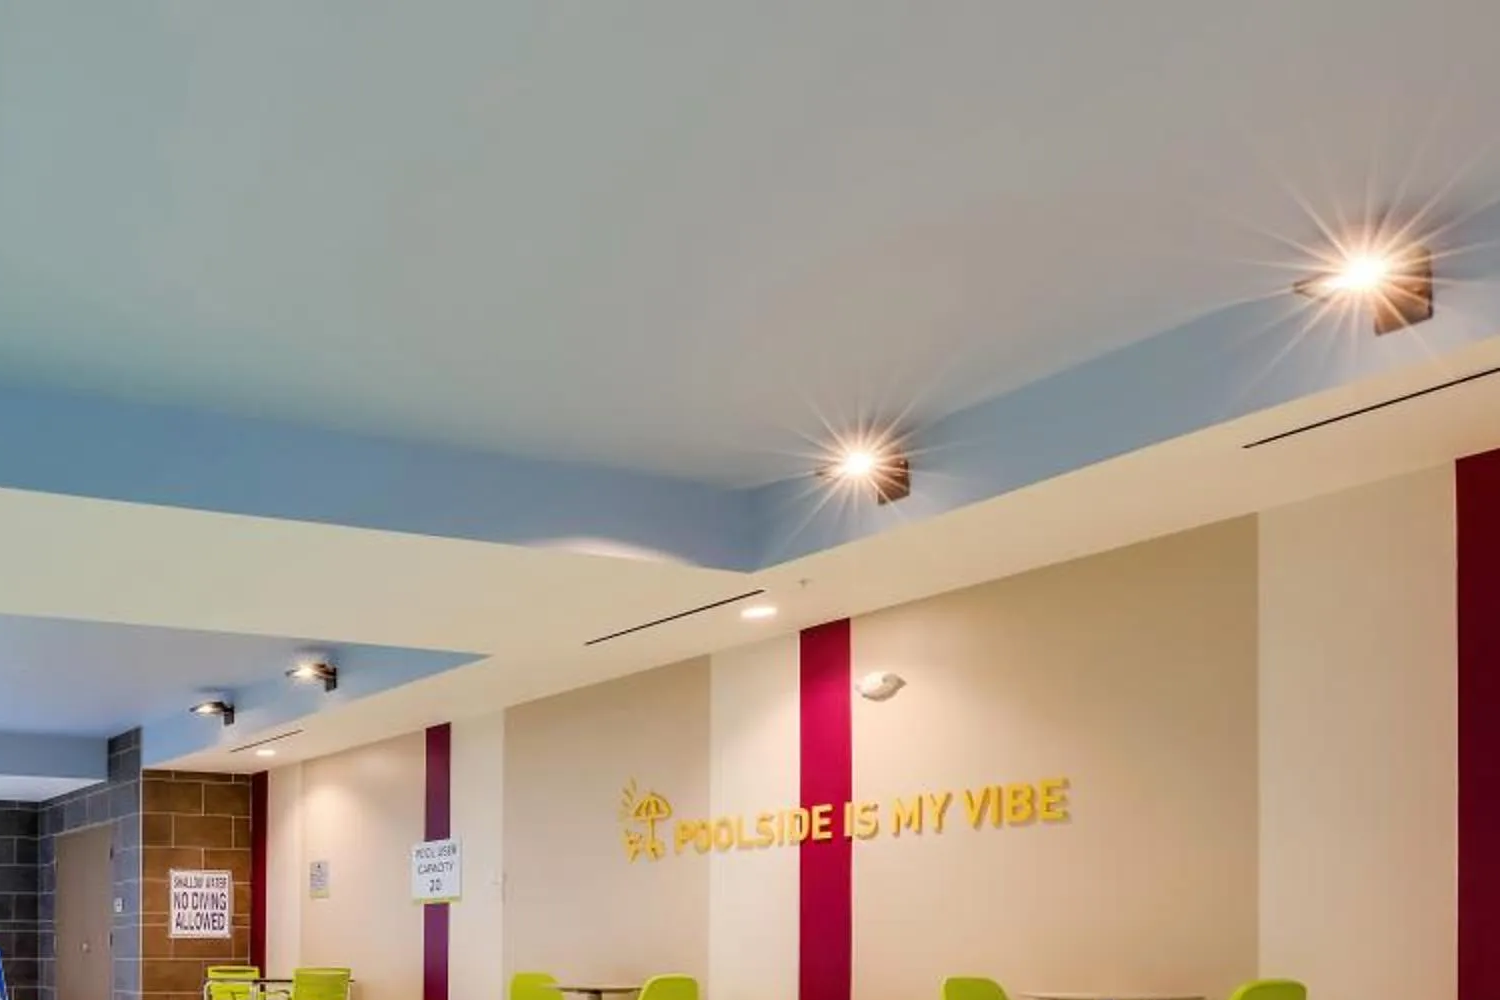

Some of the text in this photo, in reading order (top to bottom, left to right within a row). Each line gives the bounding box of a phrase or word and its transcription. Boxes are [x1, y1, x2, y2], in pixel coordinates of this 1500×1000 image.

[674, 778, 1070, 855] POOLSIDE IS MY VIBE
[174, 892, 227, 910] NO DIVING
[176, 912, 225, 930] ALLOWED
